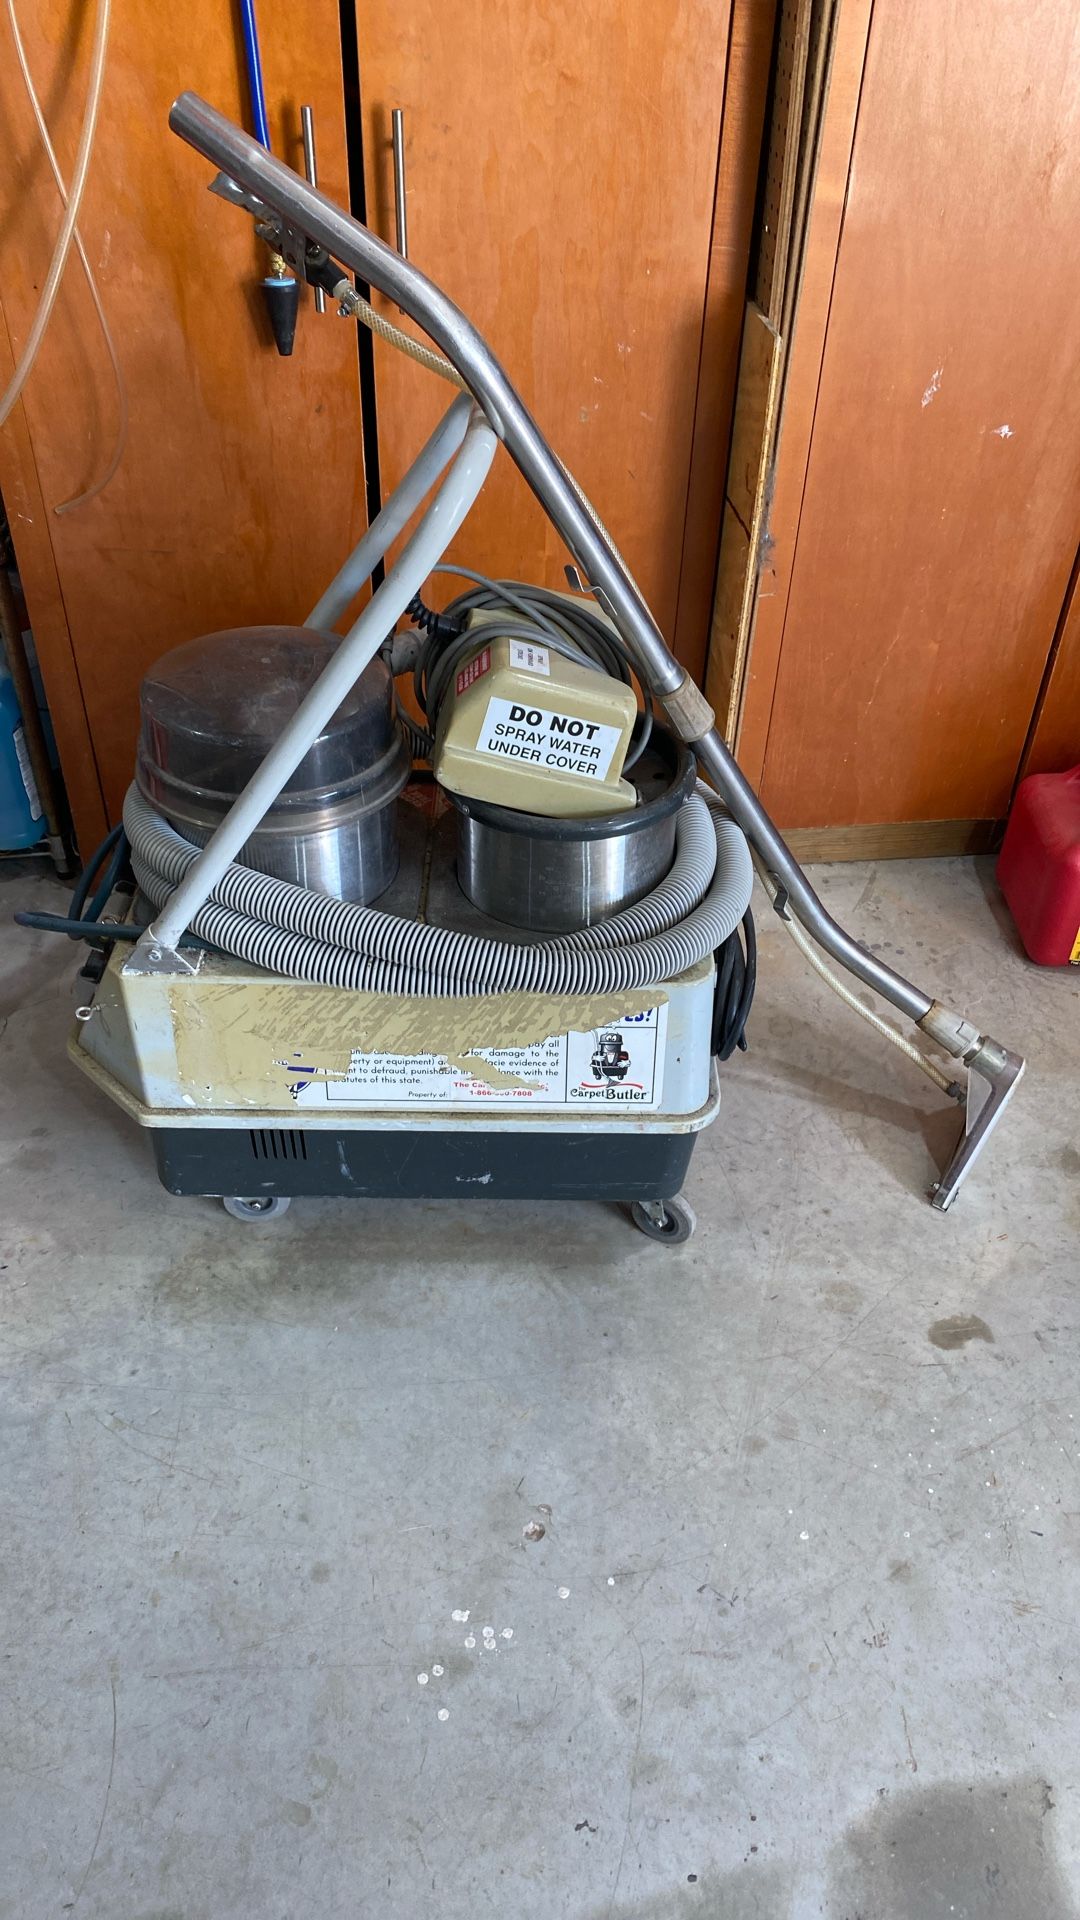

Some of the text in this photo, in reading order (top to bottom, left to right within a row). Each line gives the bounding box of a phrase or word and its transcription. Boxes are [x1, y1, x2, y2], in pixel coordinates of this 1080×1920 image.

[509, 705, 600, 740] DO NOT
[494, 723, 601, 759] SPRAY WATER
[488, 739, 598, 775] UNDER COVER
[548, 1039, 560, 1048] all
[471, 1048, 483, 1056] for
[488, 1049, 525, 1058] damage
[386, 1058, 435, 1066] equipment)
[508, 1059, 547, 1067] evidence
[550, 1059, 560, 1067] of
[371, 1067, 408, 1075] defraud,
[410, 1067, 457, 1075] punishable
[523, 1068, 543, 1076] with
[545, 1068, 559, 1076] the
[370, 1076, 378, 1084] of
[381, 1076, 397, 1084] this
[570, 1088, 647, 1100] Carpet Butler
